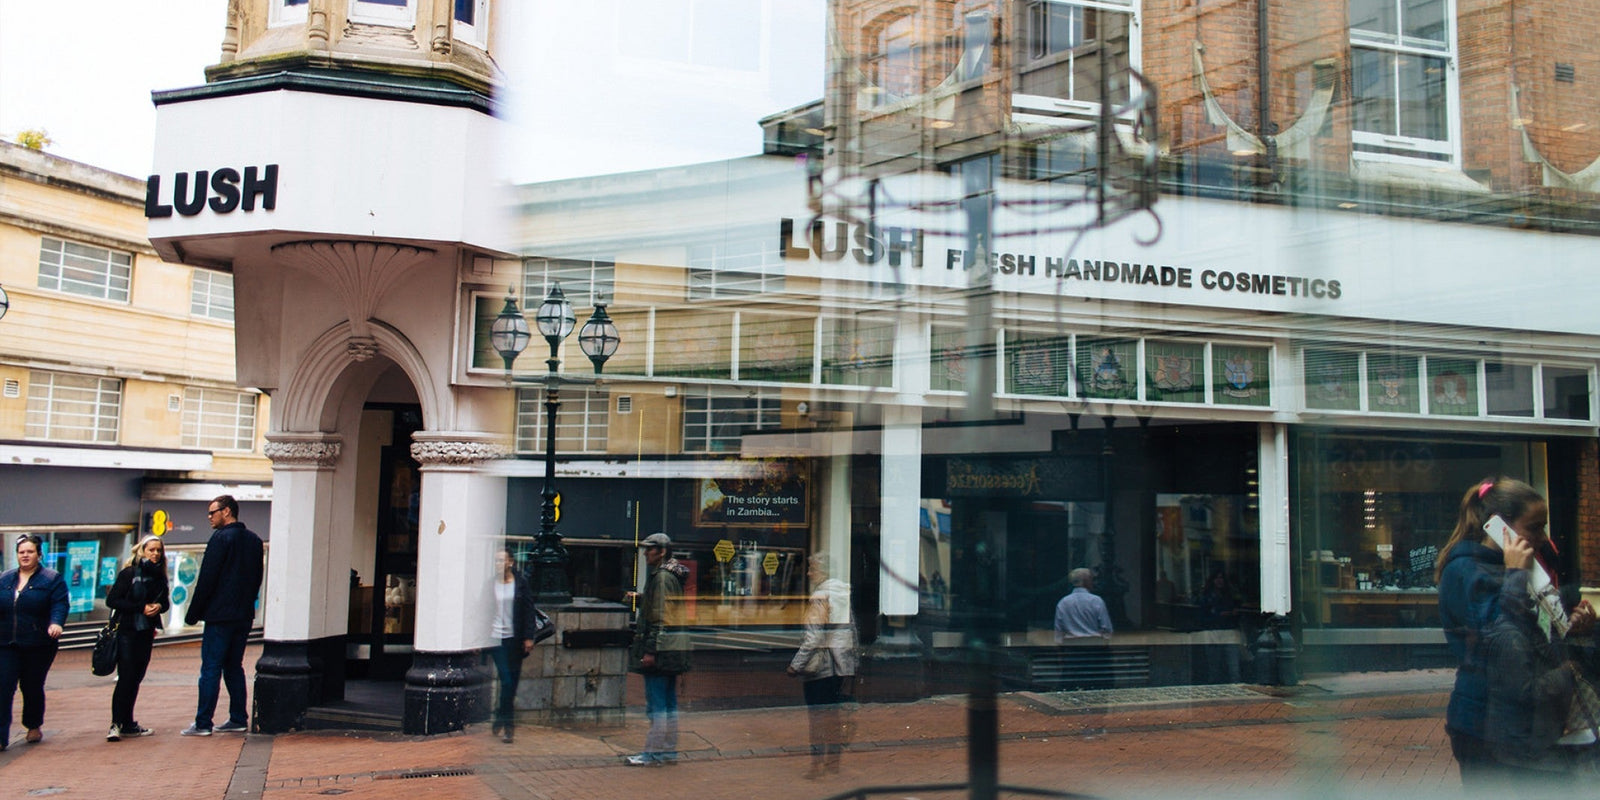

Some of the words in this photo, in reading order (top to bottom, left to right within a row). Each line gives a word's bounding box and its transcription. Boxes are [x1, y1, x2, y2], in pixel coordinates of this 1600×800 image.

[144, 163, 279, 219] LUSH
[780, 217, 924, 268] LUSH
[1045, 256, 1193, 289] HANDMADE
[1200, 269, 1342, 300] COSMETICS
[726, 507, 736, 516] in
[737, 507, 780, 516] Zambia...
[727, 495, 745, 504] The
[746, 496, 770, 505] story
[772, 496, 799, 505] starts
